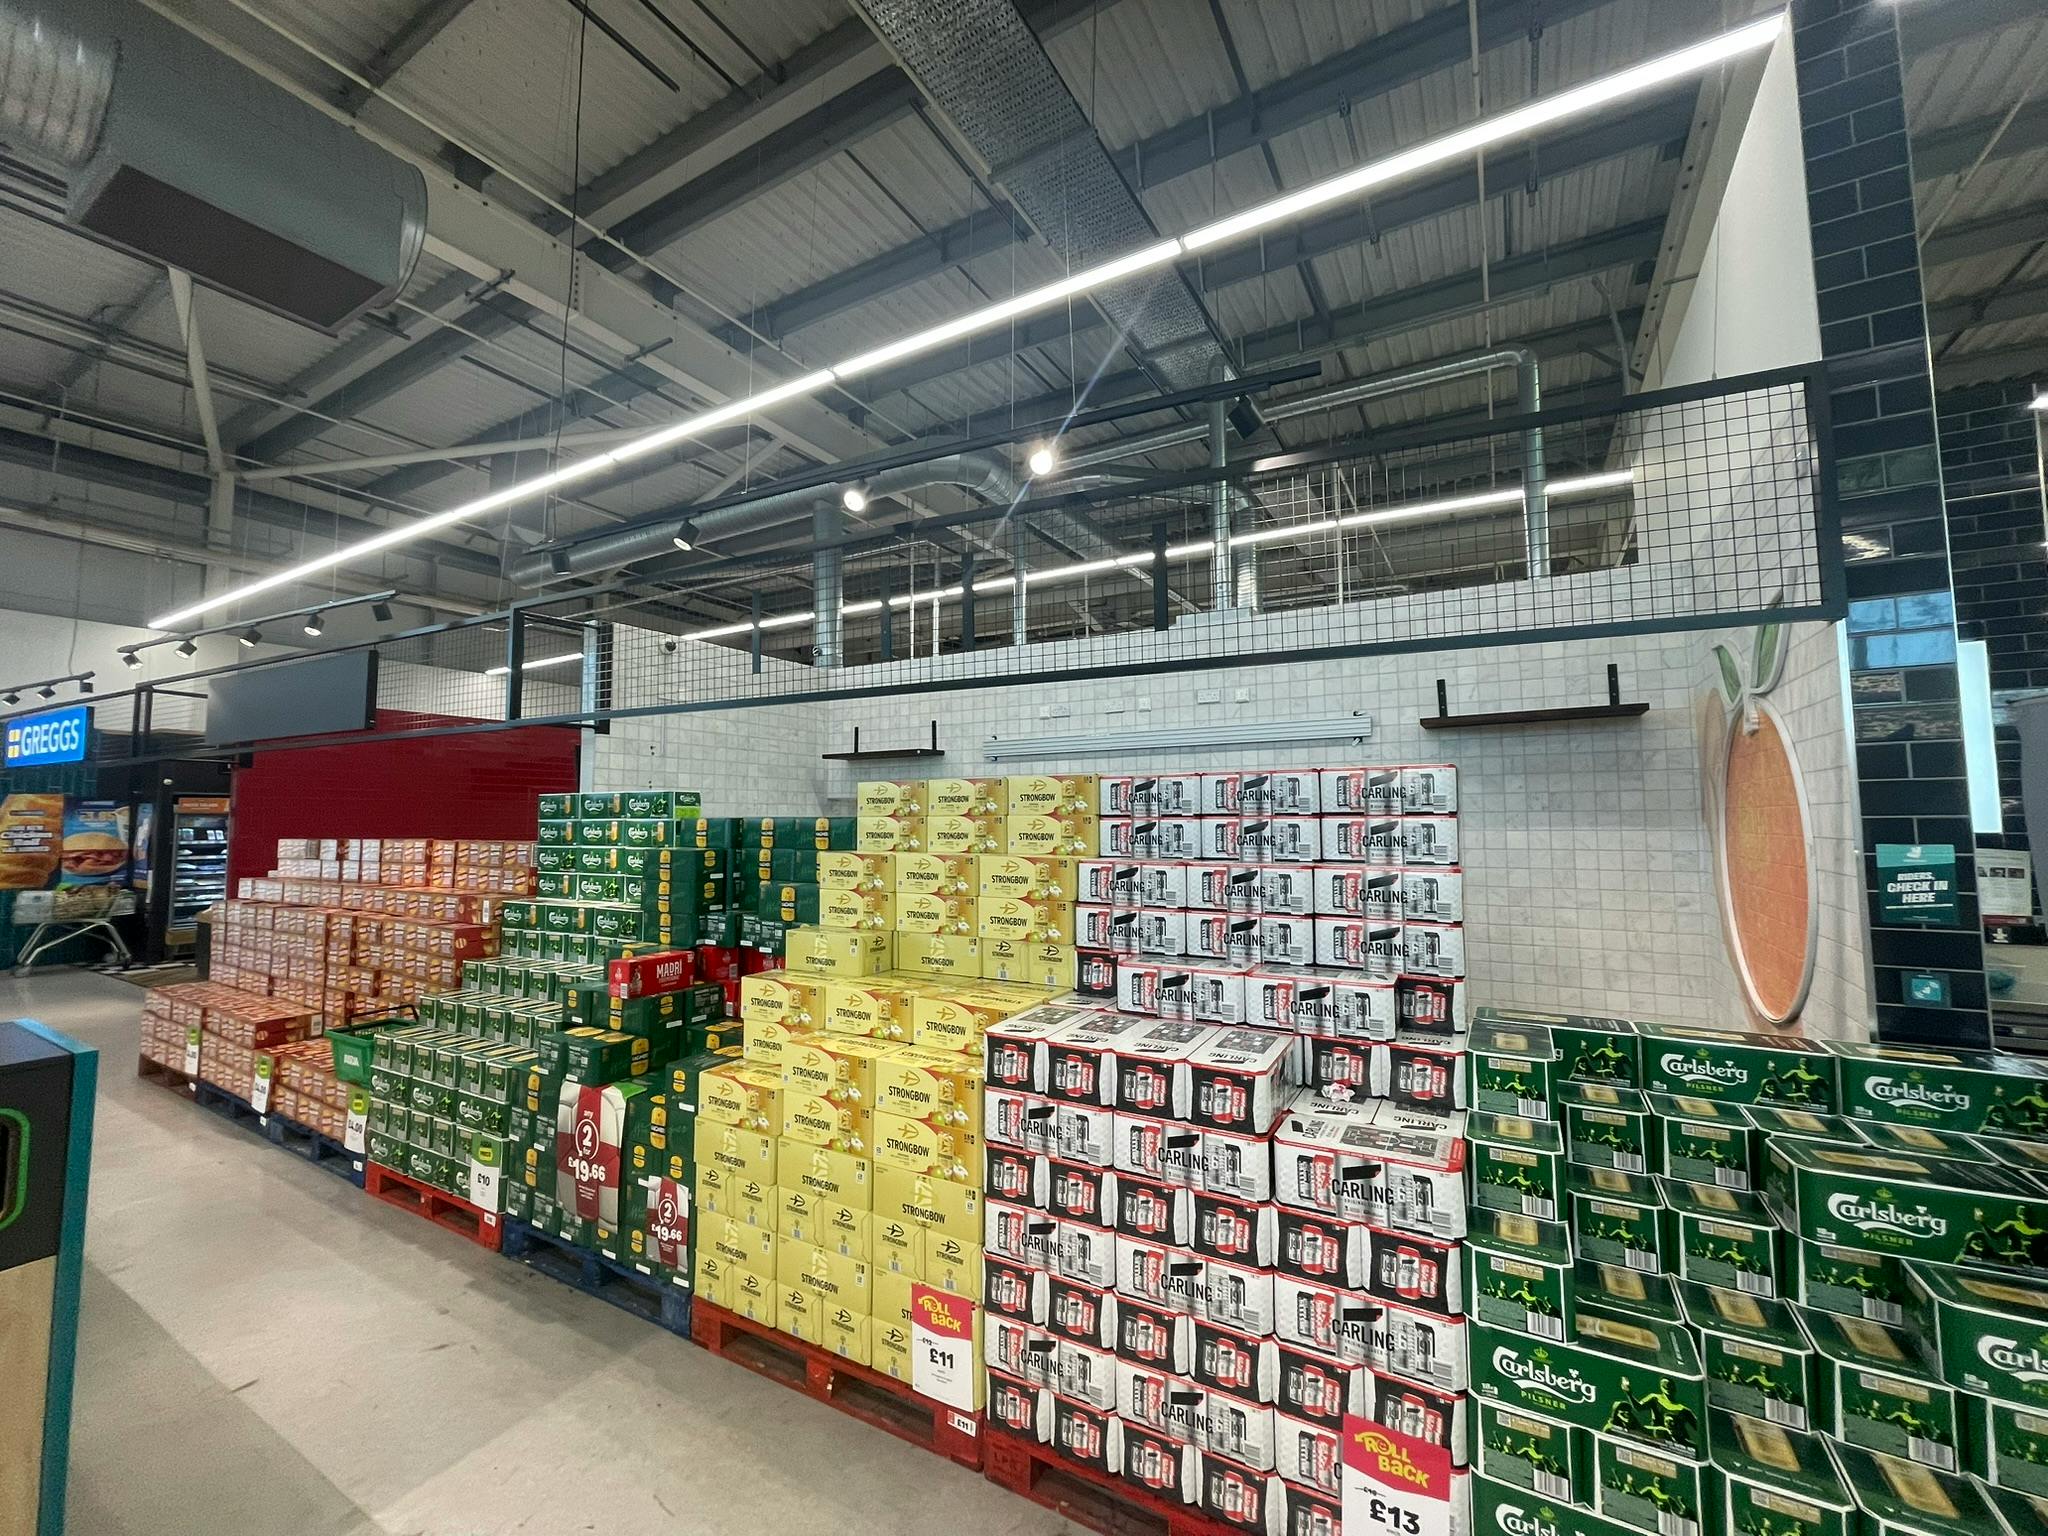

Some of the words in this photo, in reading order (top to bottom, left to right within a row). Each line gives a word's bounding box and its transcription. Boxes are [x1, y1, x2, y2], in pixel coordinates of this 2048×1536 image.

[21, 719, 80, 756] GREGGS
[866, 796, 895, 805] STRONGBOW
[938, 795, 970, 804] STRONGBOW
[1020, 792, 1056, 802] STRONGBOW
[1128, 792, 1162, 804] CARLING
[1236, 790, 1276, 801] CARLING
[1361, 787, 1406, 799] CARLING
[629, 798, 650, 812] Carlsberg
[583, 826, 602, 840] Carlsberg
[628, 826, 648, 840] Carlsberg
[865, 832, 894, 840] STRONGBOW
[936, 832, 969, 840] STRONGBOW
[1018, 832, 1055, 842] STRONGBOW
[1129, 834, 1163, 846] CARLING
[1236, 836, 1276, 847] CARLING
[1362, 836, 1408, 848] CARLING
[828, 869, 858, 878] STRONGBOW
[906, 872, 940, 881] STRONGBOW
[992, 874, 1029, 885] STRONGBOW
[1897, 872, 1935, 881] RIDERS,
[581, 880, 602, 894] Carlsberg
[1110, 880, 1146, 892] CARLING
[1224, 886, 1266, 898] CARLING
[1887, 882, 1930, 892] CHECK
[1934, 880, 1948, 890] IN
[1359, 890, 1408, 904] CARLING
[1902, 892, 1936, 903] HERE
[828, 906, 858, 916] STRONGBOW
[906, 910, 940, 921] STRONGBOW
[597, 915, 618, 930] Carlsberg
[989, 915, 1028, 928] STRONGBOW
[1107, 926, 1144, 938] CARLING
[1224, 933, 1266, 946] CARLING
[1360, 942, 1410, 957] CARLING
[806, 956, 838, 968] STRONGBOW
[920, 956, 955, 968] STRONGBOW
[750, 996, 783, 1010] STRONGBOW
[1154, 988, 1198, 1004] CARLING
[836, 1007, 872, 1022] STRONGBOW
[1290, 1000, 1340, 1018] CARLING
[926, 1021, 966, 1036] STRONGBOW
[1208, 1052, 1258, 1064] CARLING
[792, 1066, 829, 1083] STRONGBOW
[1660, 1053, 1748, 1086] Carlsberg
[888, 1086, 931, 1104] STRONGBOW
[1864, 1075, 1970, 1112] Carlsberg
[708, 1095, 742, 1112] STRONGBOW
[1311, 1101, 1360, 1116] CARLING
[794, 1114, 832, 1132] STRONGBOW
[1020, 1118, 1063, 1140] CARLING
[1394, 1115, 1448, 1130] CARLING
[582, 1125, 592, 1146] 2
[886, 1138, 930, 1158] STRONGBOW
[714, 1152, 746, 1169] STRONGBOW
[1158, 1146, 1210, 1172] CARLING
[568, 1157, 606, 1182] £19.66
[478, 1173, 490, 1186] £10
[802, 1174, 840, 1194] STRONGBOW
[1332, 1179, 1394, 1206] CARLING
[664, 1202, 672, 1218] 2
[902, 1204, 946, 1225] STRONGBOW
[1828, 1192, 1947, 1239] Carlsberg
[652, 1223, 682, 1242] £19.66
[1862, 1232, 1914, 1247] PILSNER
[716, 1241, 748, 1261] STRONGBOW
[1021, 1234, 1064, 1258] CARLING
[936, 1250, 964, 1266] STRONGBOW
[801, 1272, 840, 1295] STRONGBOW
[1160, 1274, 1213, 1301] CARLING
[924, 1297, 950, 1316] ROLL
[1332, 1319, 1395, 1351] CARLING
[930, 1348, 954, 1369] £11
[1020, 1350, 1064, 1377] CARLING
[1492, 1346, 1597, 1404] Carlsberg
[1520, 1390, 1568, 1411] PILSNER
[957, 1418, 968, 1431] £11
[1161, 1402, 1214, 1433] CARLING
[1364, 1438, 1411, 1464] ROLL
[1370, 1499, 1420, 1534] £13
